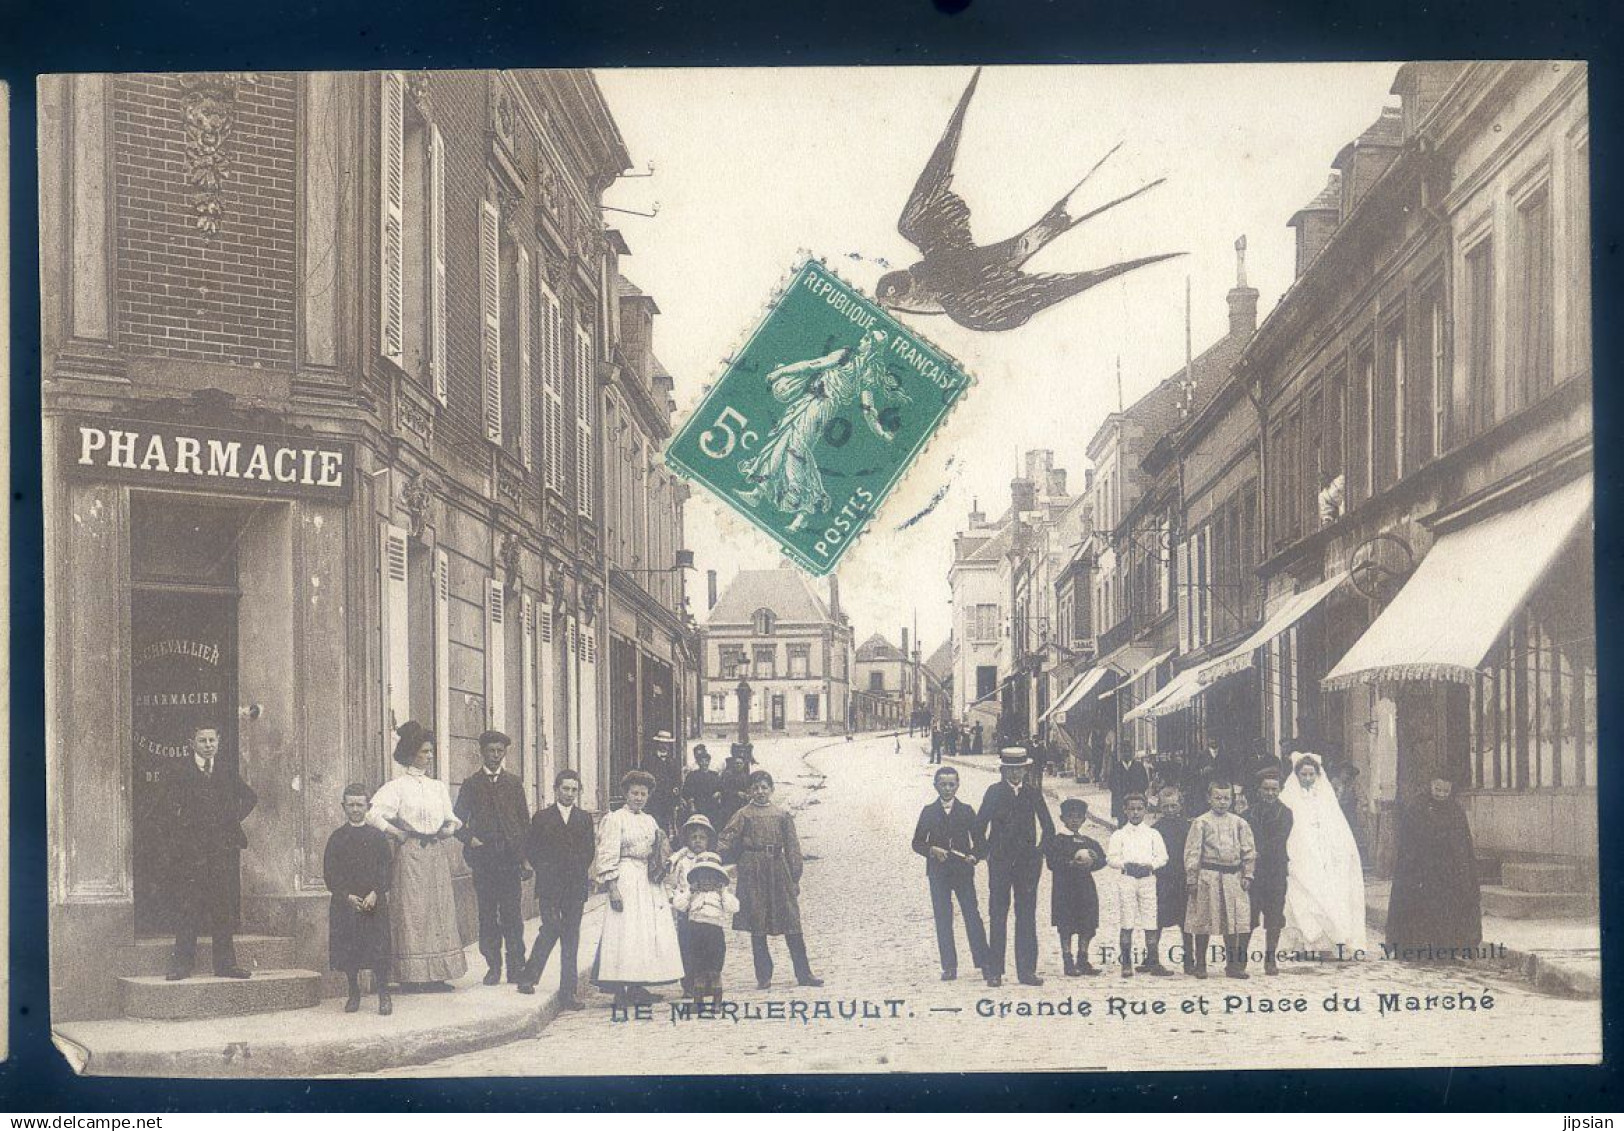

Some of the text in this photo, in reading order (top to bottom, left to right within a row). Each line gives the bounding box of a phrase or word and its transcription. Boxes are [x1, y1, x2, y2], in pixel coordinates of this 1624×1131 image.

[78, 427, 343, 487] PHARMACIE
[814, 486, 872, 556] POSTES
[136, 692, 218, 705] PHARMACIEN
